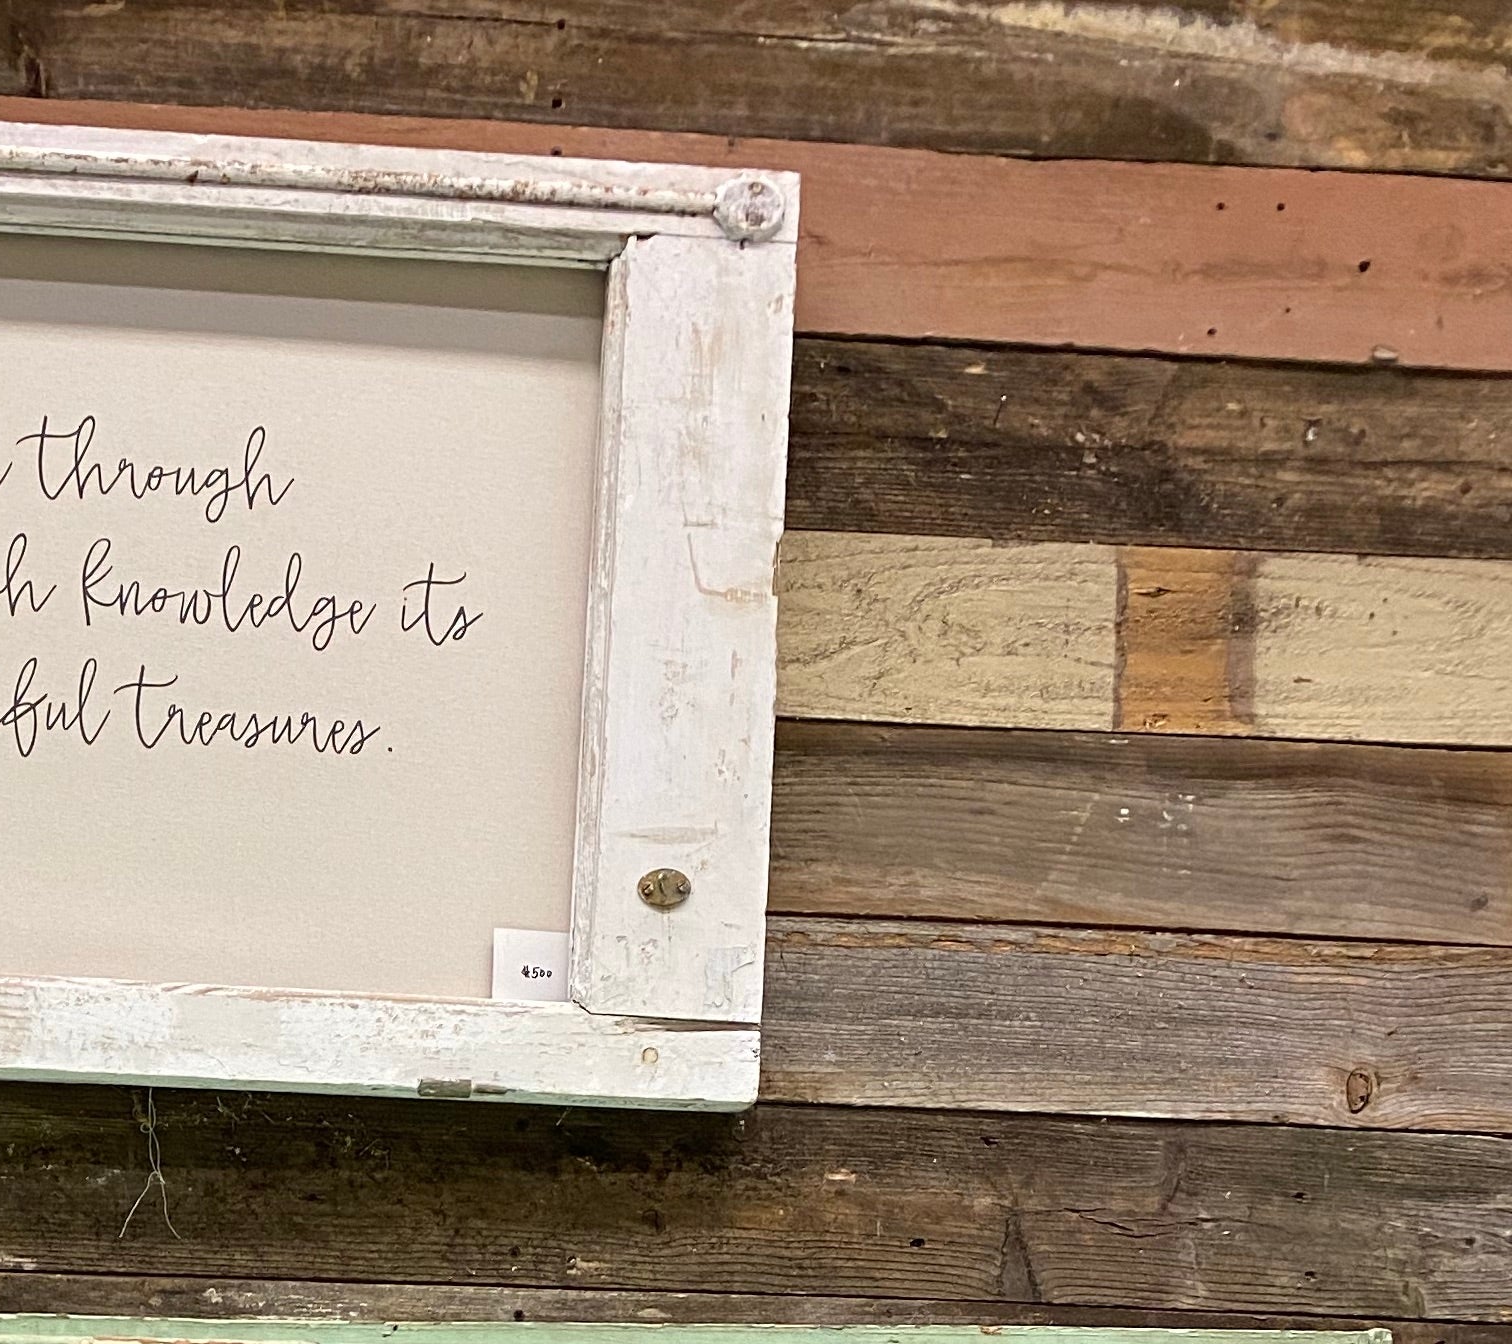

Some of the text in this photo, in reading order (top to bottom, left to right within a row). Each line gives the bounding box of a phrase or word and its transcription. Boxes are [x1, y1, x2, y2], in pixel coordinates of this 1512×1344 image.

[16, 415, 295, 523] through
[401, 562, 484, 646] its
[114, 665, 393, 755] treasures.
